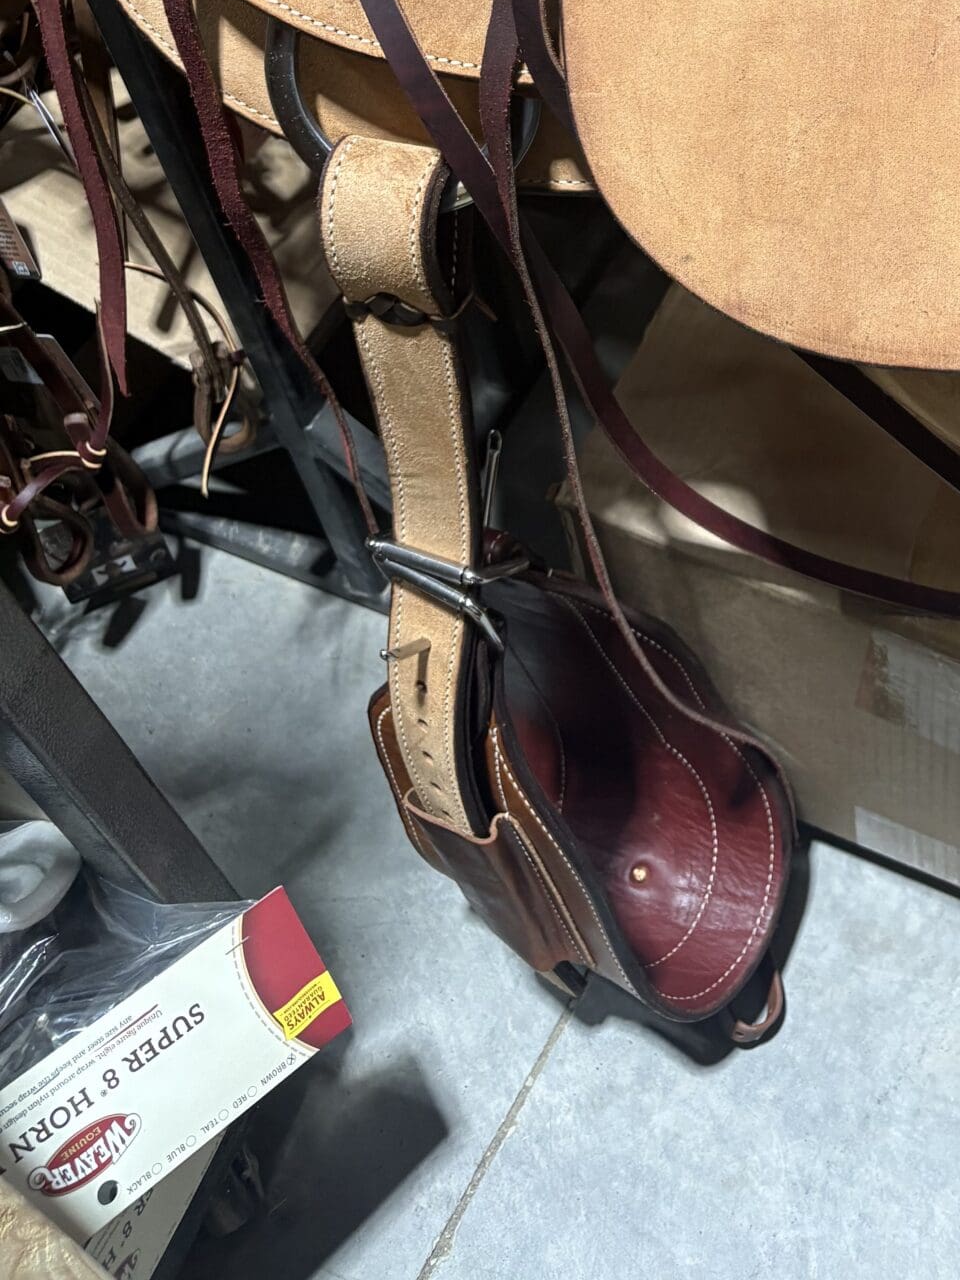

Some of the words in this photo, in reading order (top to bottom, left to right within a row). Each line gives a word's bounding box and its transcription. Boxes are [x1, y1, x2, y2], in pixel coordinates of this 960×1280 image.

[283, 985, 322, 1021] GUARANTEED
[286, 990, 326, 1030] ALWAYS
[117, 1014, 133, 1028] any
[134, 1008, 163, 1031] Unique
[113, 1026, 137, 1047] figure
[121, 1004, 206, 1073] SUPER
[71, 1049, 87, 1063] and
[74, 1057, 96, 1075] wrap
[48, 1072, 77, 1096] around
[259, 1061, 287, 1086] BROWN
[231, 1093, 248, 1109] RED
[9, 1088, 95, 1163] HORN
[199, 1117, 218, 1134] TEAL
[28, 1113, 141, 1191] WEAVER
[59, 1126, 101, 1161] EQUINE
[165, 1143, 186, 1162] BLUE
[125, 1170, 152, 1194] BLACK
